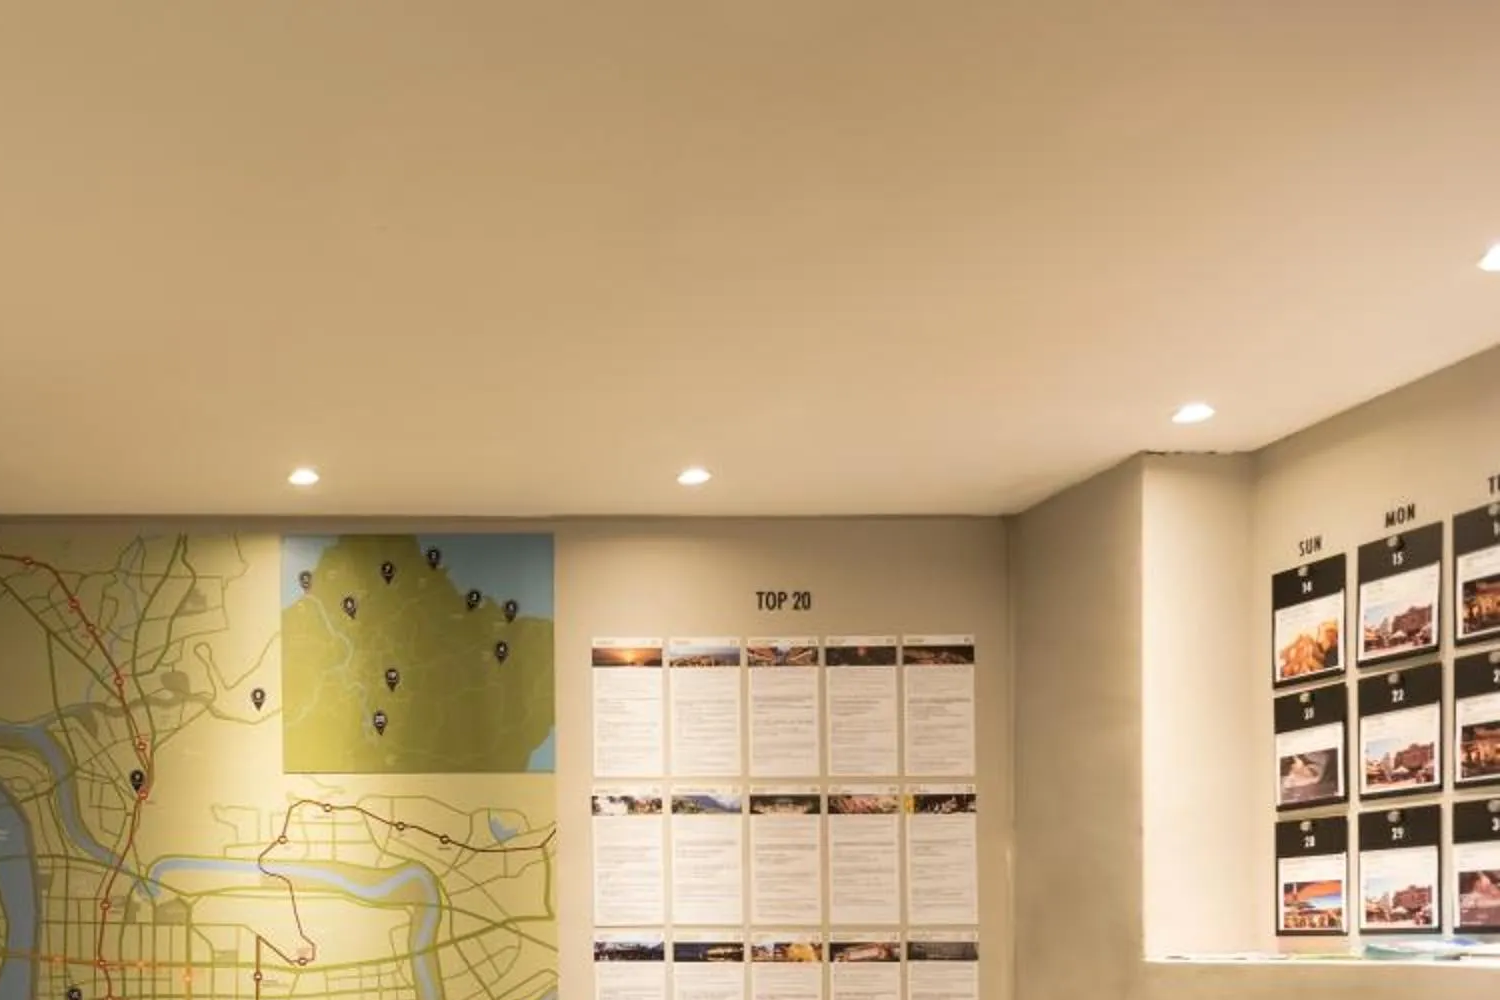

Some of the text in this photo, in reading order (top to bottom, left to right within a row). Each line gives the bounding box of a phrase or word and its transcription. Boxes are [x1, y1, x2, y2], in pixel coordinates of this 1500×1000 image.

[1385, 504, 1416, 528] MON
[1299, 536, 1322, 557] SUN
[1392, 551, 1404, 566] 15
[1302, 580, 1313, 594] 14
[755, 591, 811, 611] TOP 20
